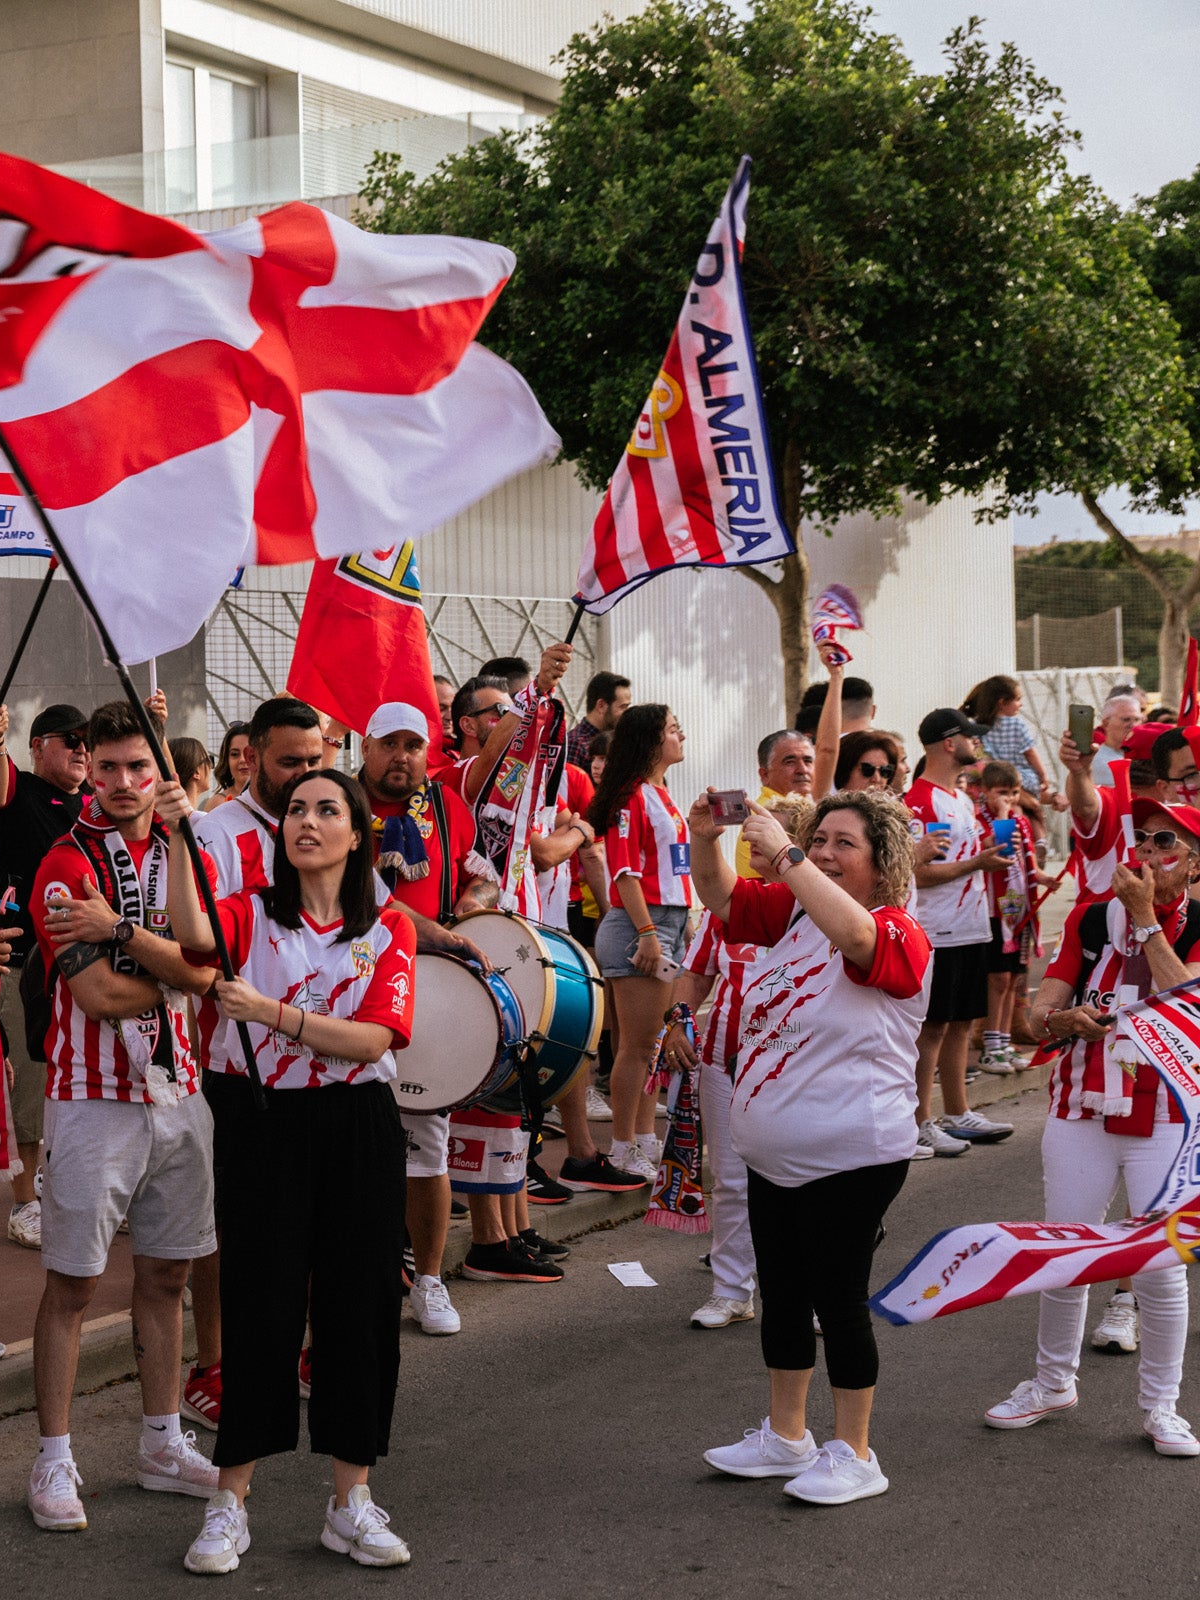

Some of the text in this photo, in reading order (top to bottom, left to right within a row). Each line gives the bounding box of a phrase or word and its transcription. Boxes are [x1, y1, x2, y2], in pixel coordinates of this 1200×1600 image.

[691, 320, 772, 557] ALMERIA
[147, 863, 160, 907] PASION
[153, 914, 166, 926] U
[1150, 1018, 1195, 1064] LOCALIA
